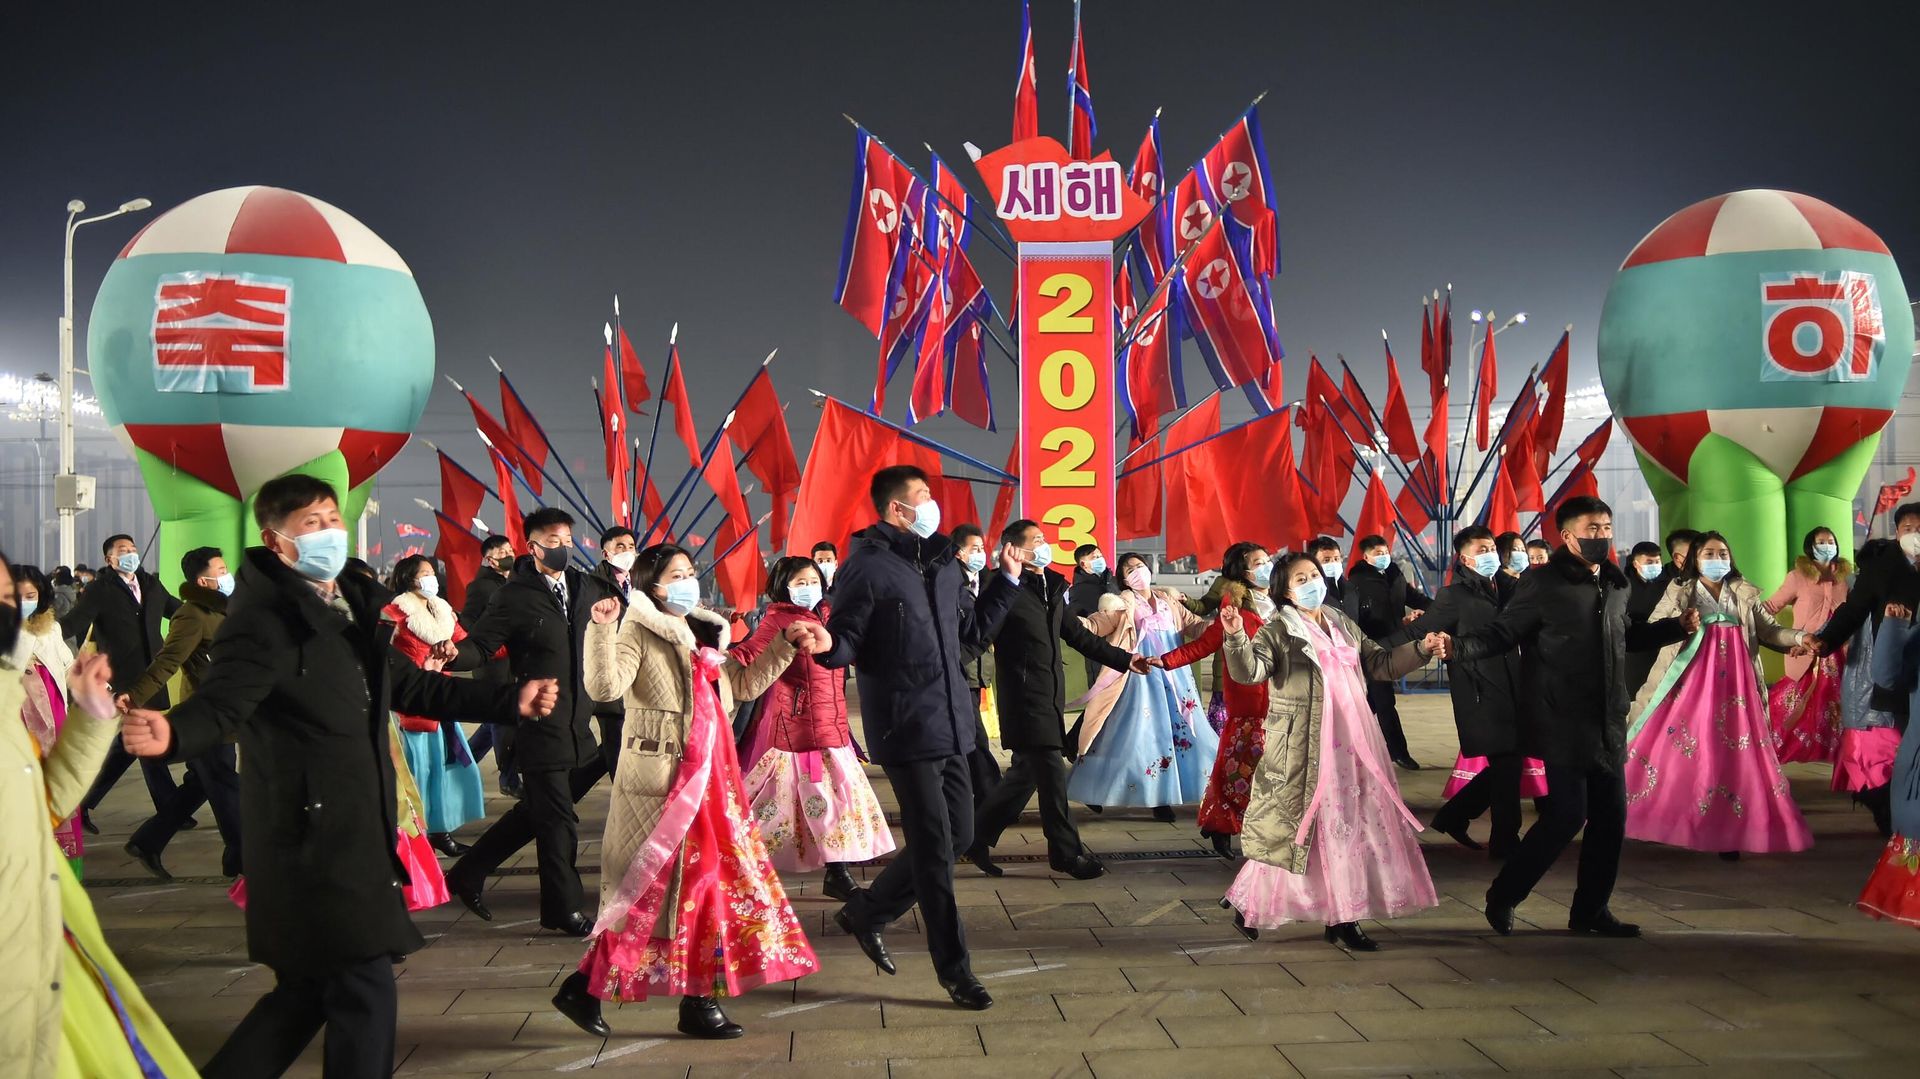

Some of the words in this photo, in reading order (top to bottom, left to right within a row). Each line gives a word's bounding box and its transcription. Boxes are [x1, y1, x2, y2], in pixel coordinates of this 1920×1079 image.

[1002, 166, 1118, 217] 새해
[155, 277, 286, 386] 축
[1766, 277, 1880, 375] 하
[1038, 272, 1098, 566] 2023
